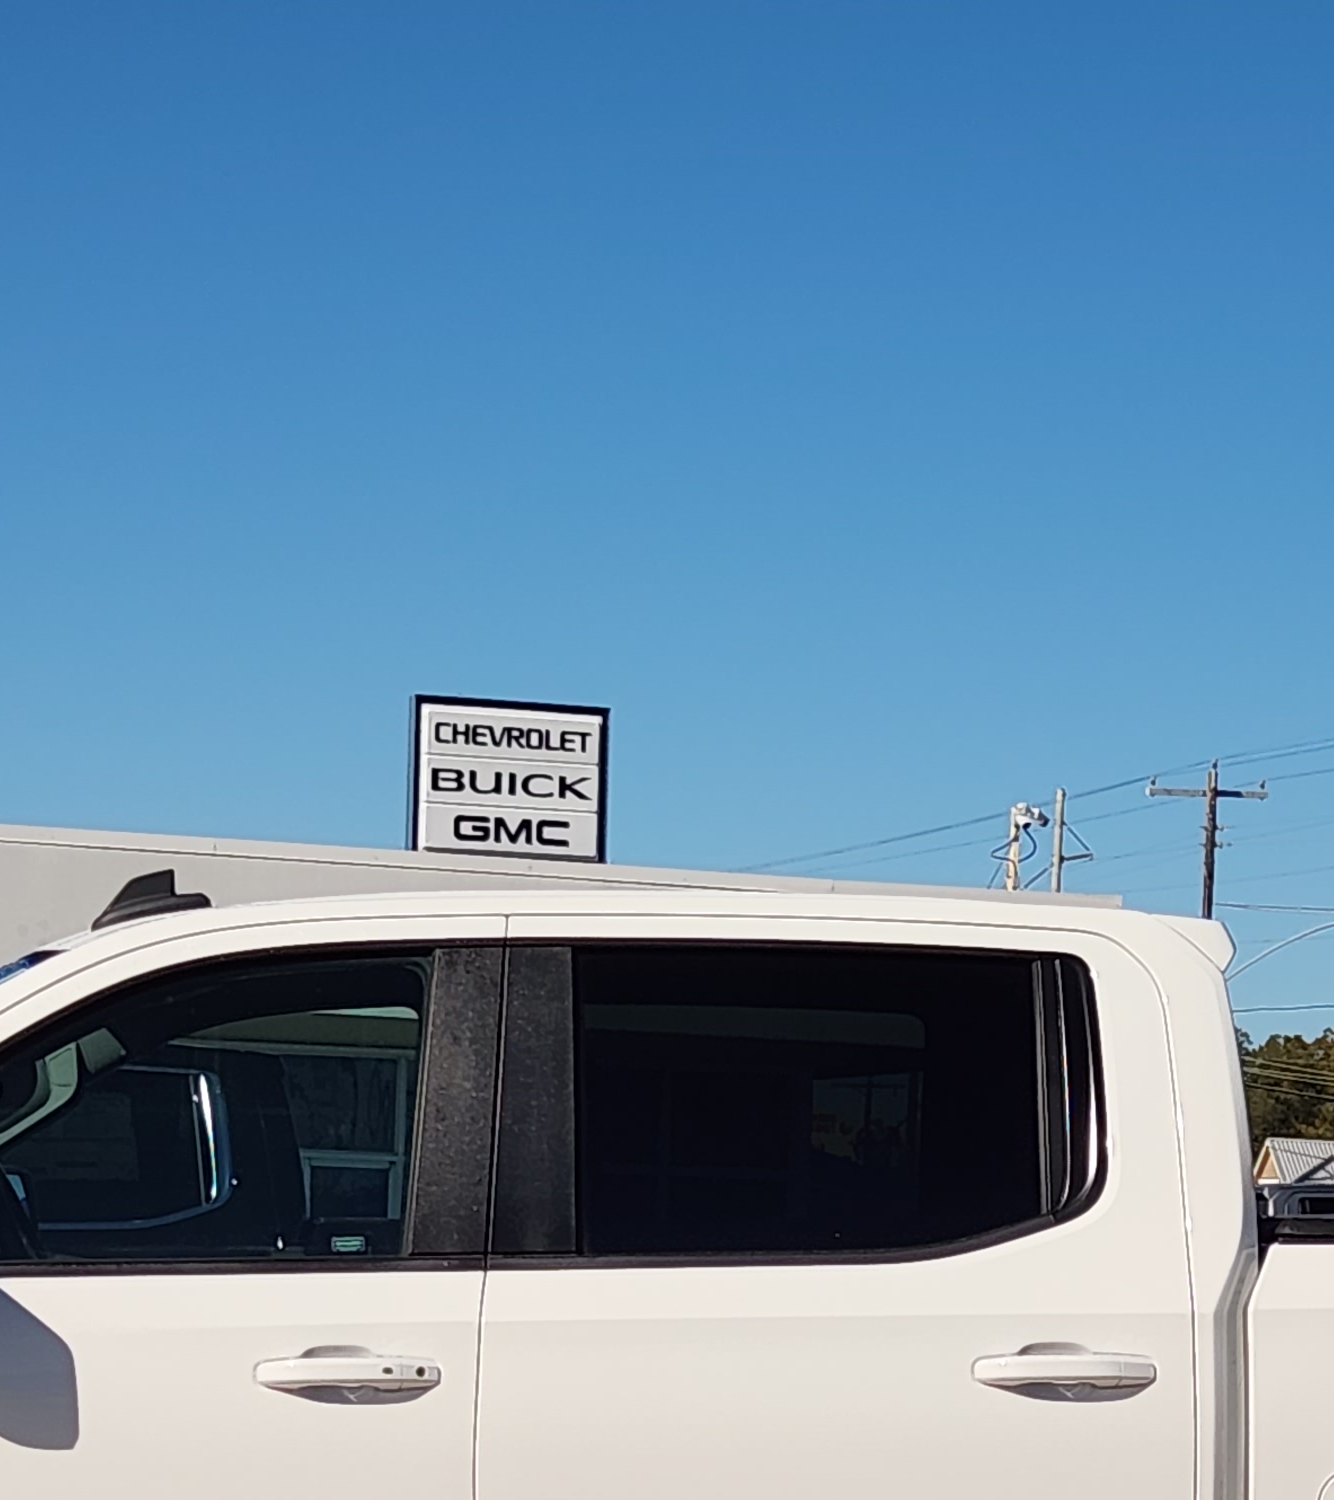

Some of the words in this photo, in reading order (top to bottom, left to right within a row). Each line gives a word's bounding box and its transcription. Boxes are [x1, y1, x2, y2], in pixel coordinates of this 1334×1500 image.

[434, 722, 593, 753] CHEVROLET
[431, 767, 593, 801] BUICK
[453, 815, 570, 848] GMC
